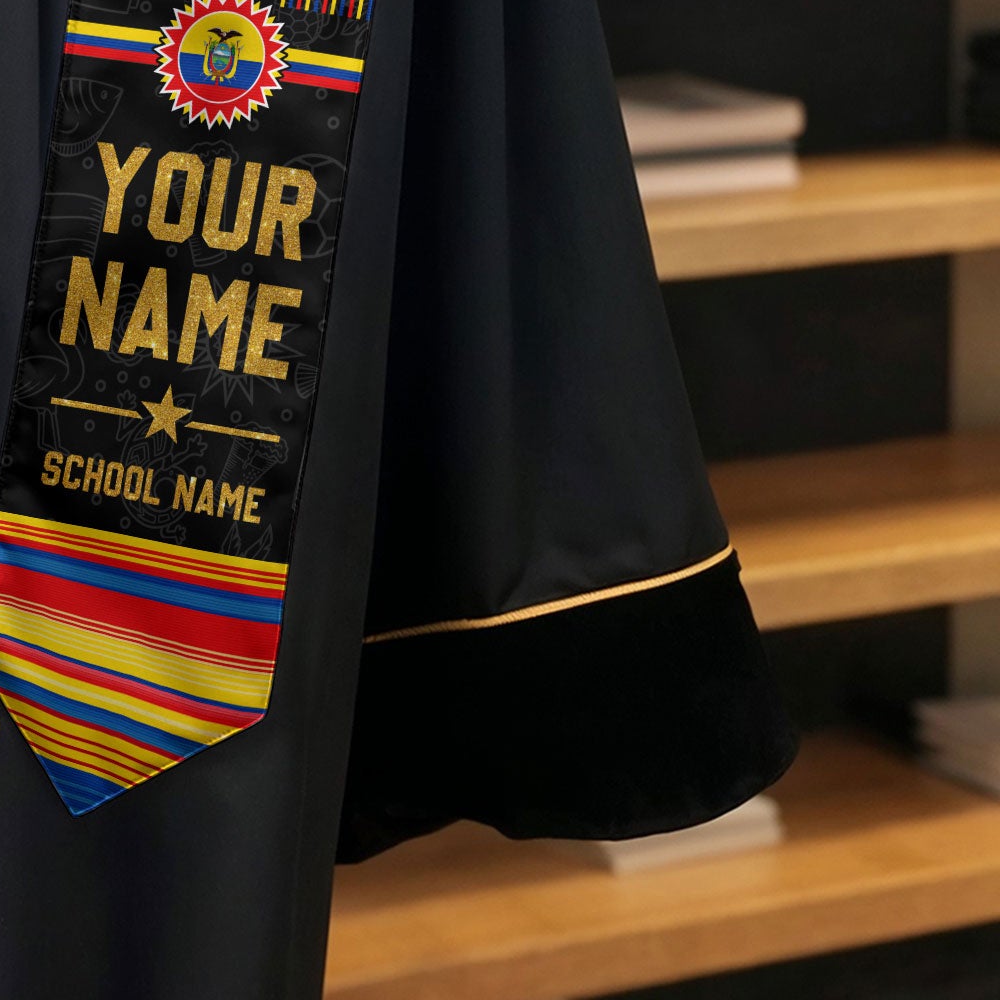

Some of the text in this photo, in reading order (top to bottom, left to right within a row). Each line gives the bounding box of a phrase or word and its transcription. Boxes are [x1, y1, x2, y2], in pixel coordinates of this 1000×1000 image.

[96, 141, 318, 262] YOUR
[59, 255, 303, 381] NAME
[40, 450, 267, 524] SCHOOL NAME
